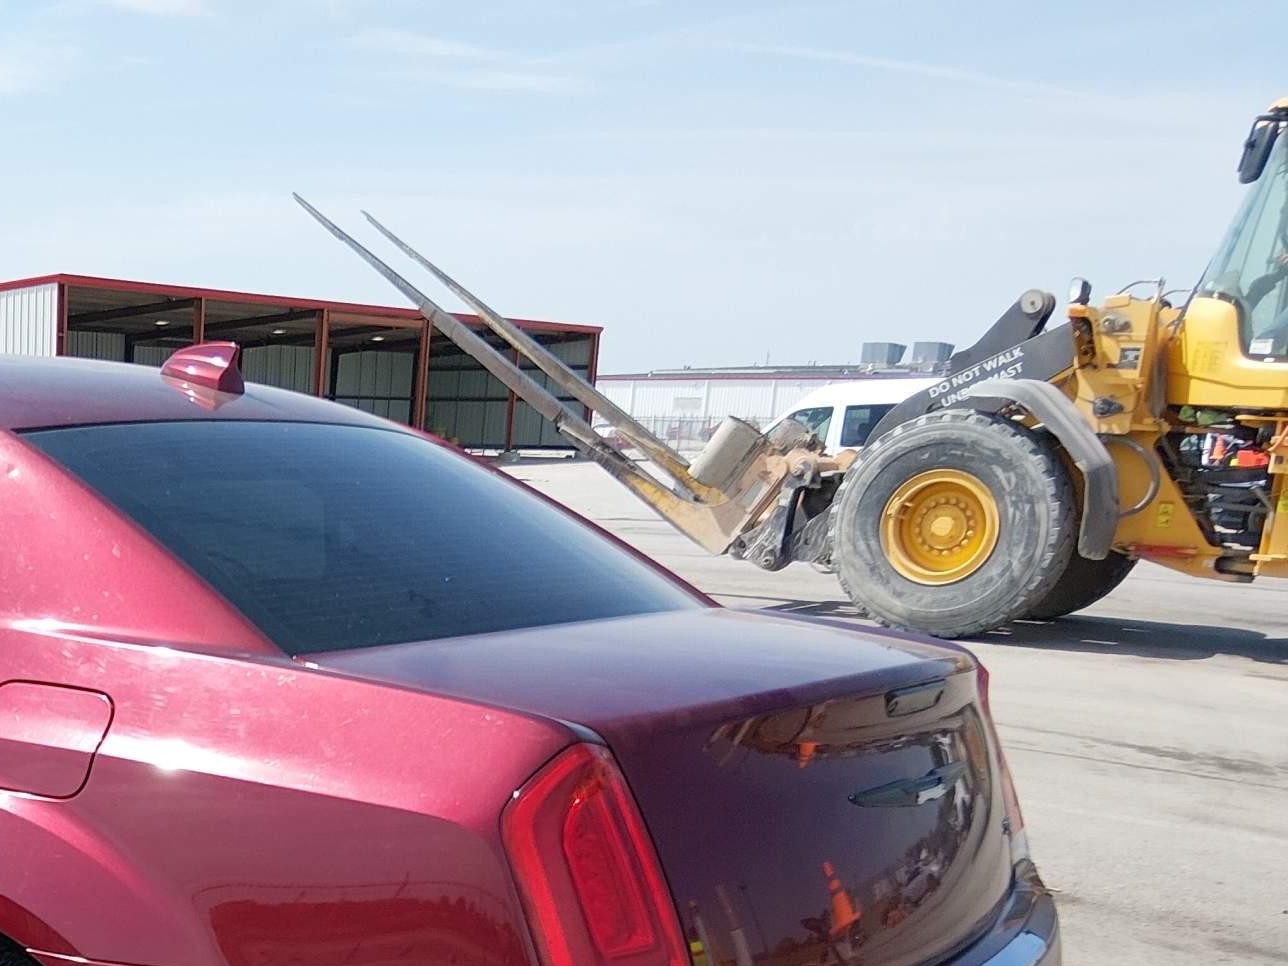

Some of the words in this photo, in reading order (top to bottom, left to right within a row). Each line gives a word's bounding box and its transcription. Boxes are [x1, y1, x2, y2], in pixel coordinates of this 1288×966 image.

[928, 382, 951, 399] DO
[952, 366, 981, 387] NOT
[982, 347, 1024, 372] WALK
